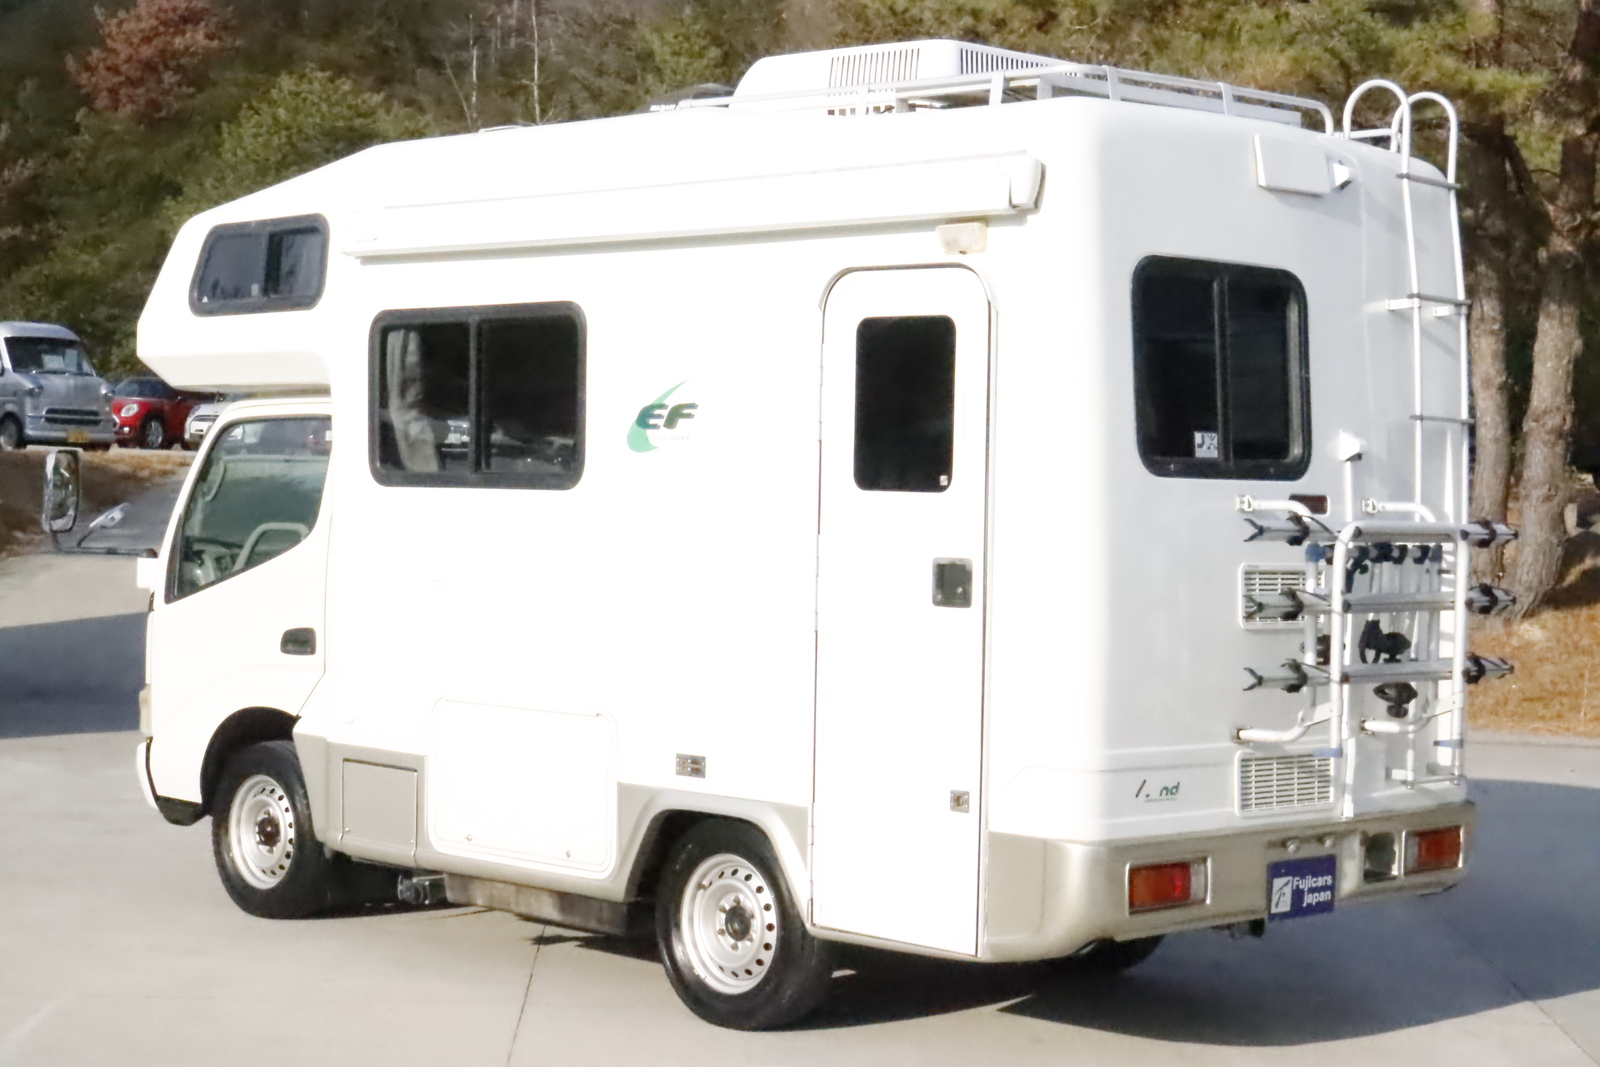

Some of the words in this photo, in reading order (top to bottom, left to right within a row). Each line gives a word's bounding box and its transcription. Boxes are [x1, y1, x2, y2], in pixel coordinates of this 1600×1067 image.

[636, 403, 698, 430] EF
[1293, 875, 1333, 891] Fujicars
[1303, 891, 1332, 907] japan
